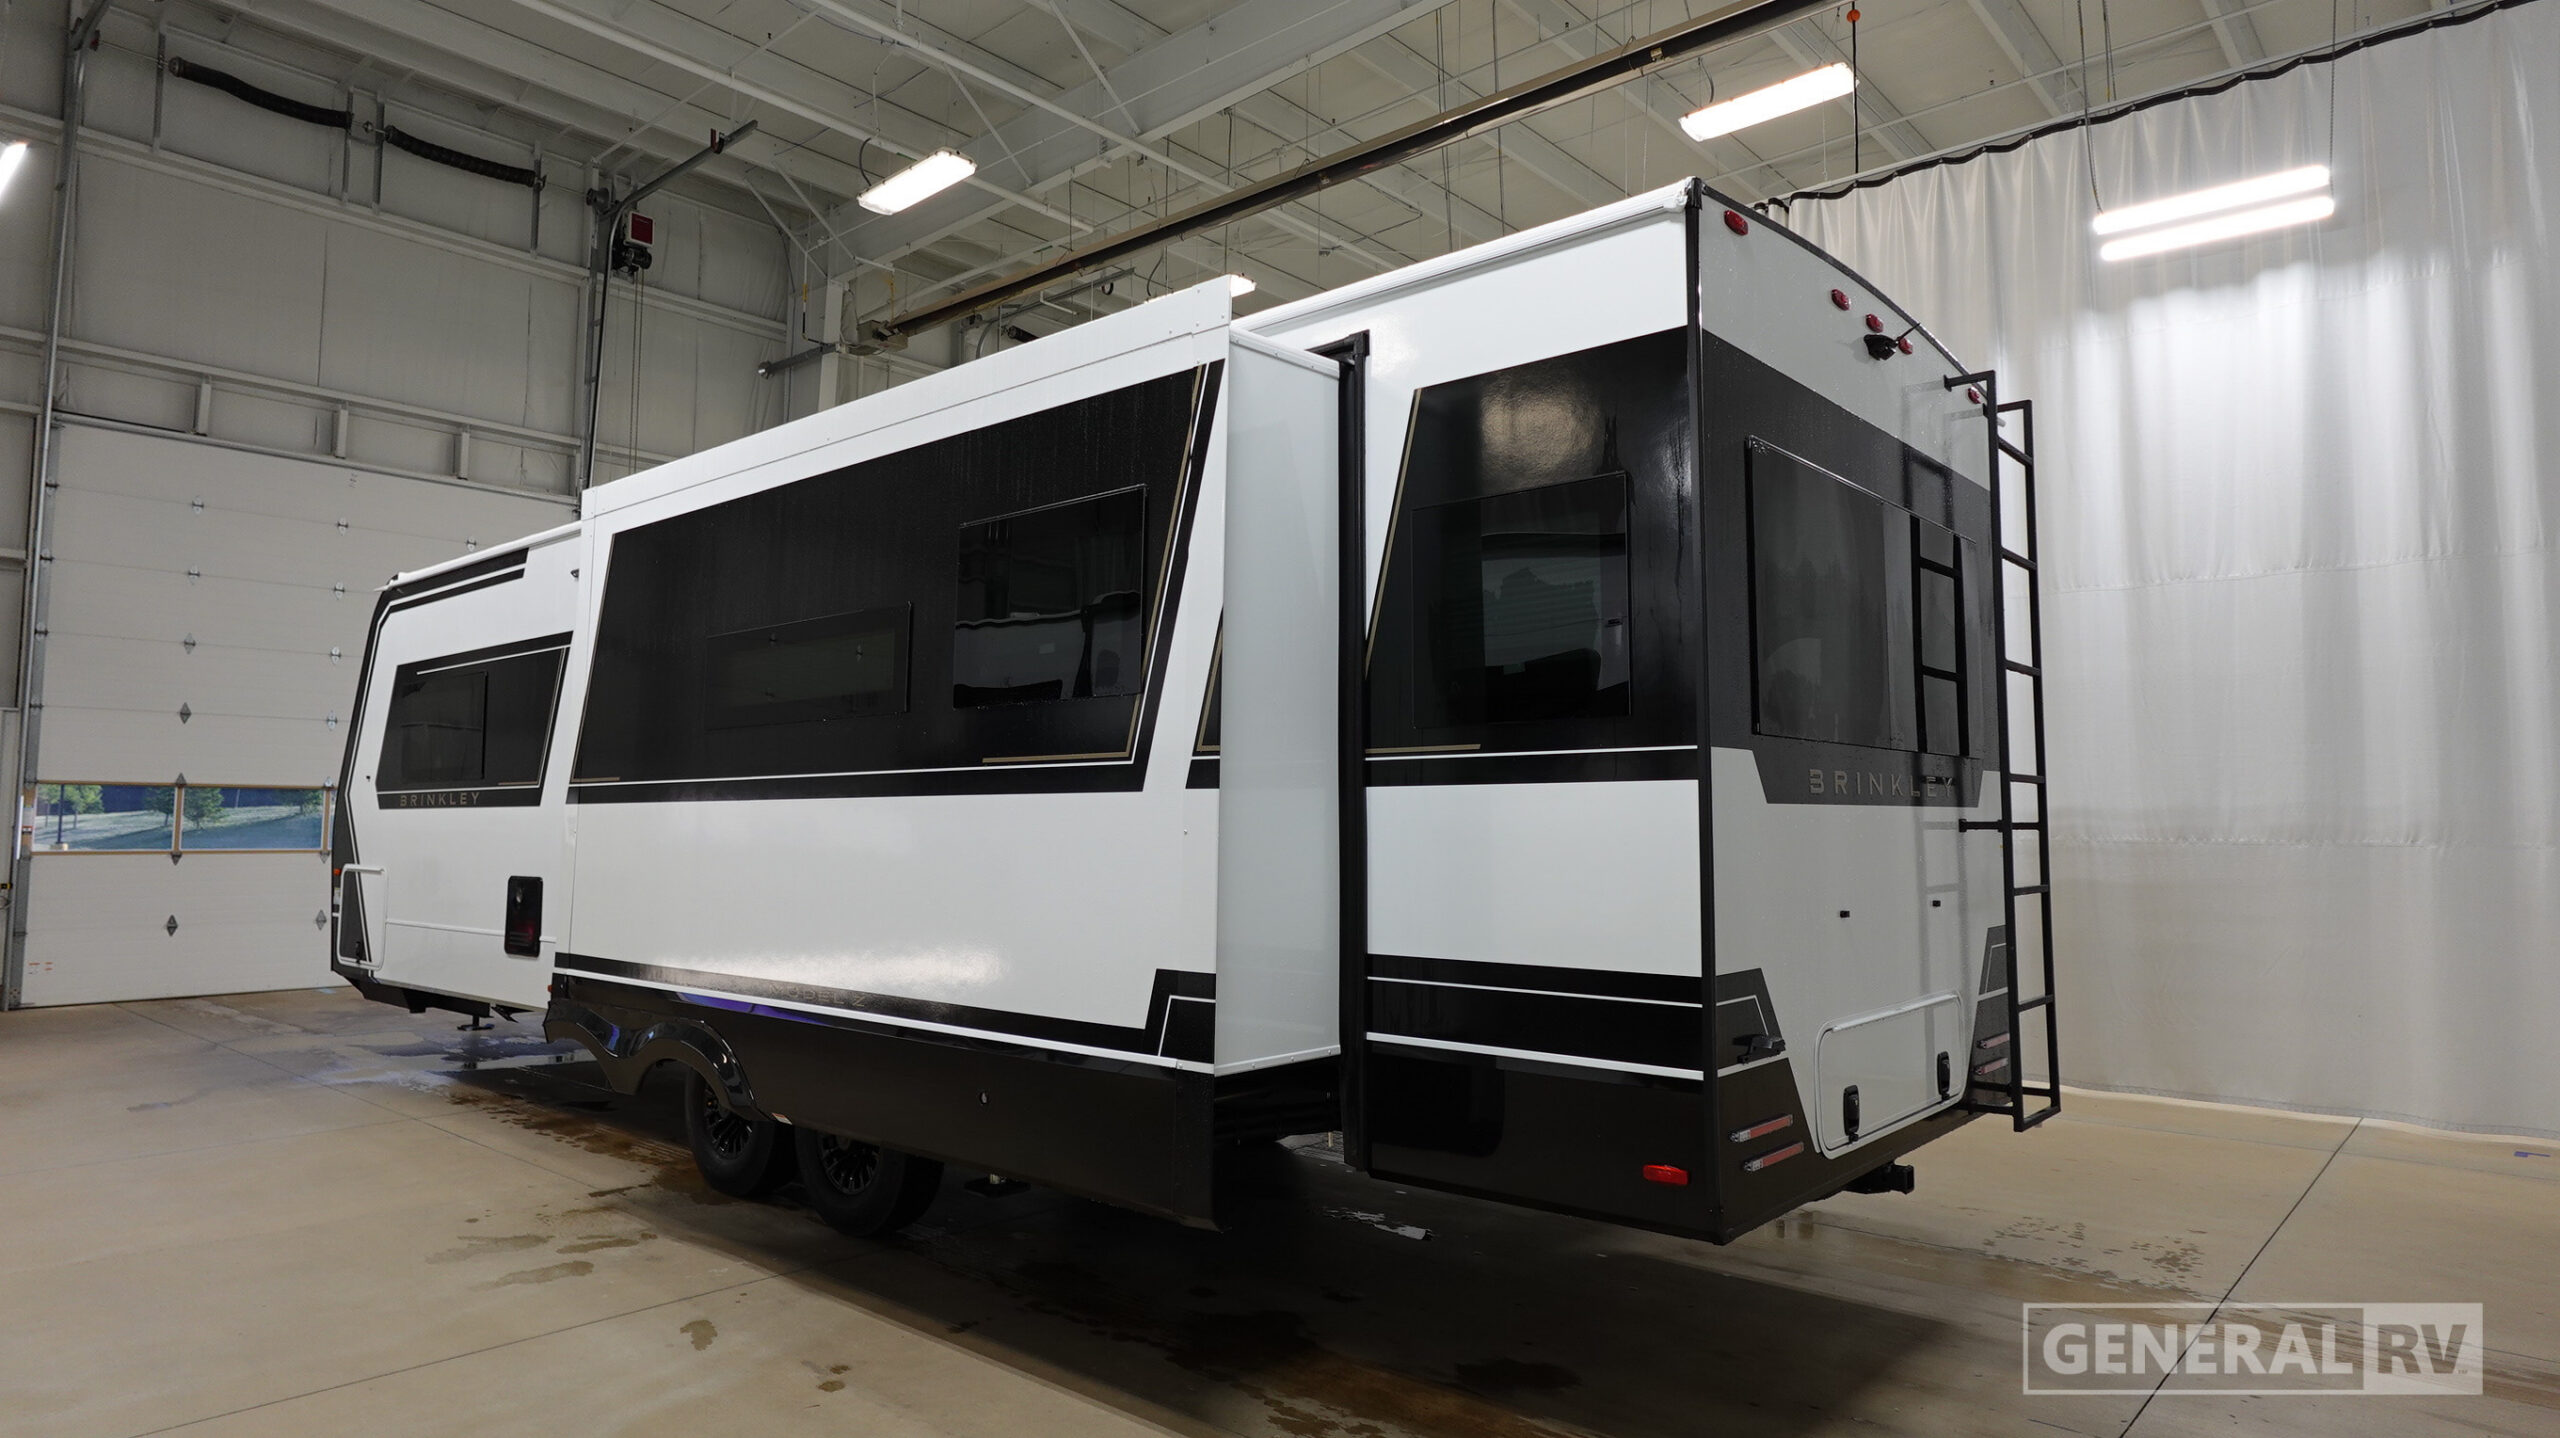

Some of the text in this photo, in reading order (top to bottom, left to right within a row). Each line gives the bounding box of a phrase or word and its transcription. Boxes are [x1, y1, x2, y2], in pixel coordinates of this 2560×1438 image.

[1809, 769, 1953, 798] BRINKLEY
[400, 792, 480, 807] BRINKLEY
[769, 983, 845, 1005] MODEL
